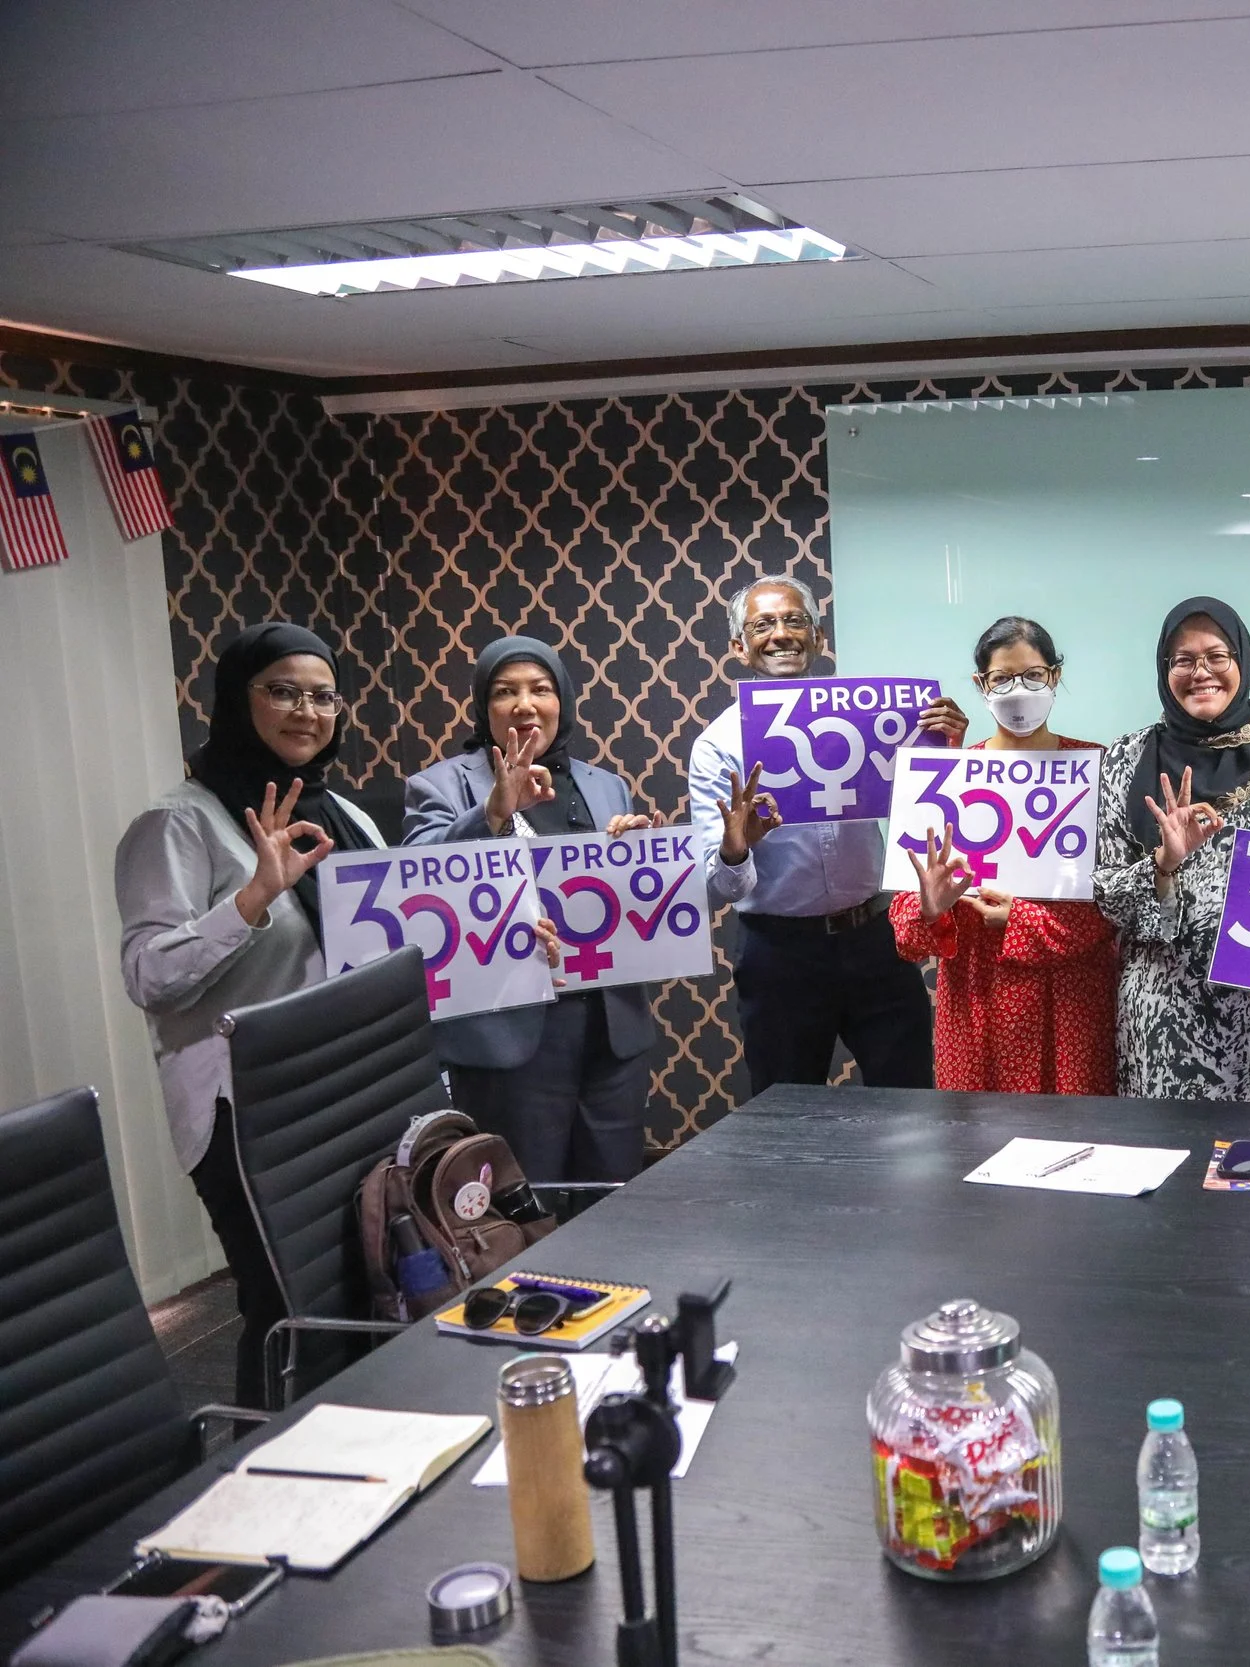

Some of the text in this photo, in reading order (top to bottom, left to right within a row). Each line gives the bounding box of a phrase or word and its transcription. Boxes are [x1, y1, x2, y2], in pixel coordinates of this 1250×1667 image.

[810, 684, 934, 712] PROJEK
[965, 760, 1091, 784] PROJEK
[400, 849, 526, 889] PROJEK
[562, 835, 695, 871] PROJEK
